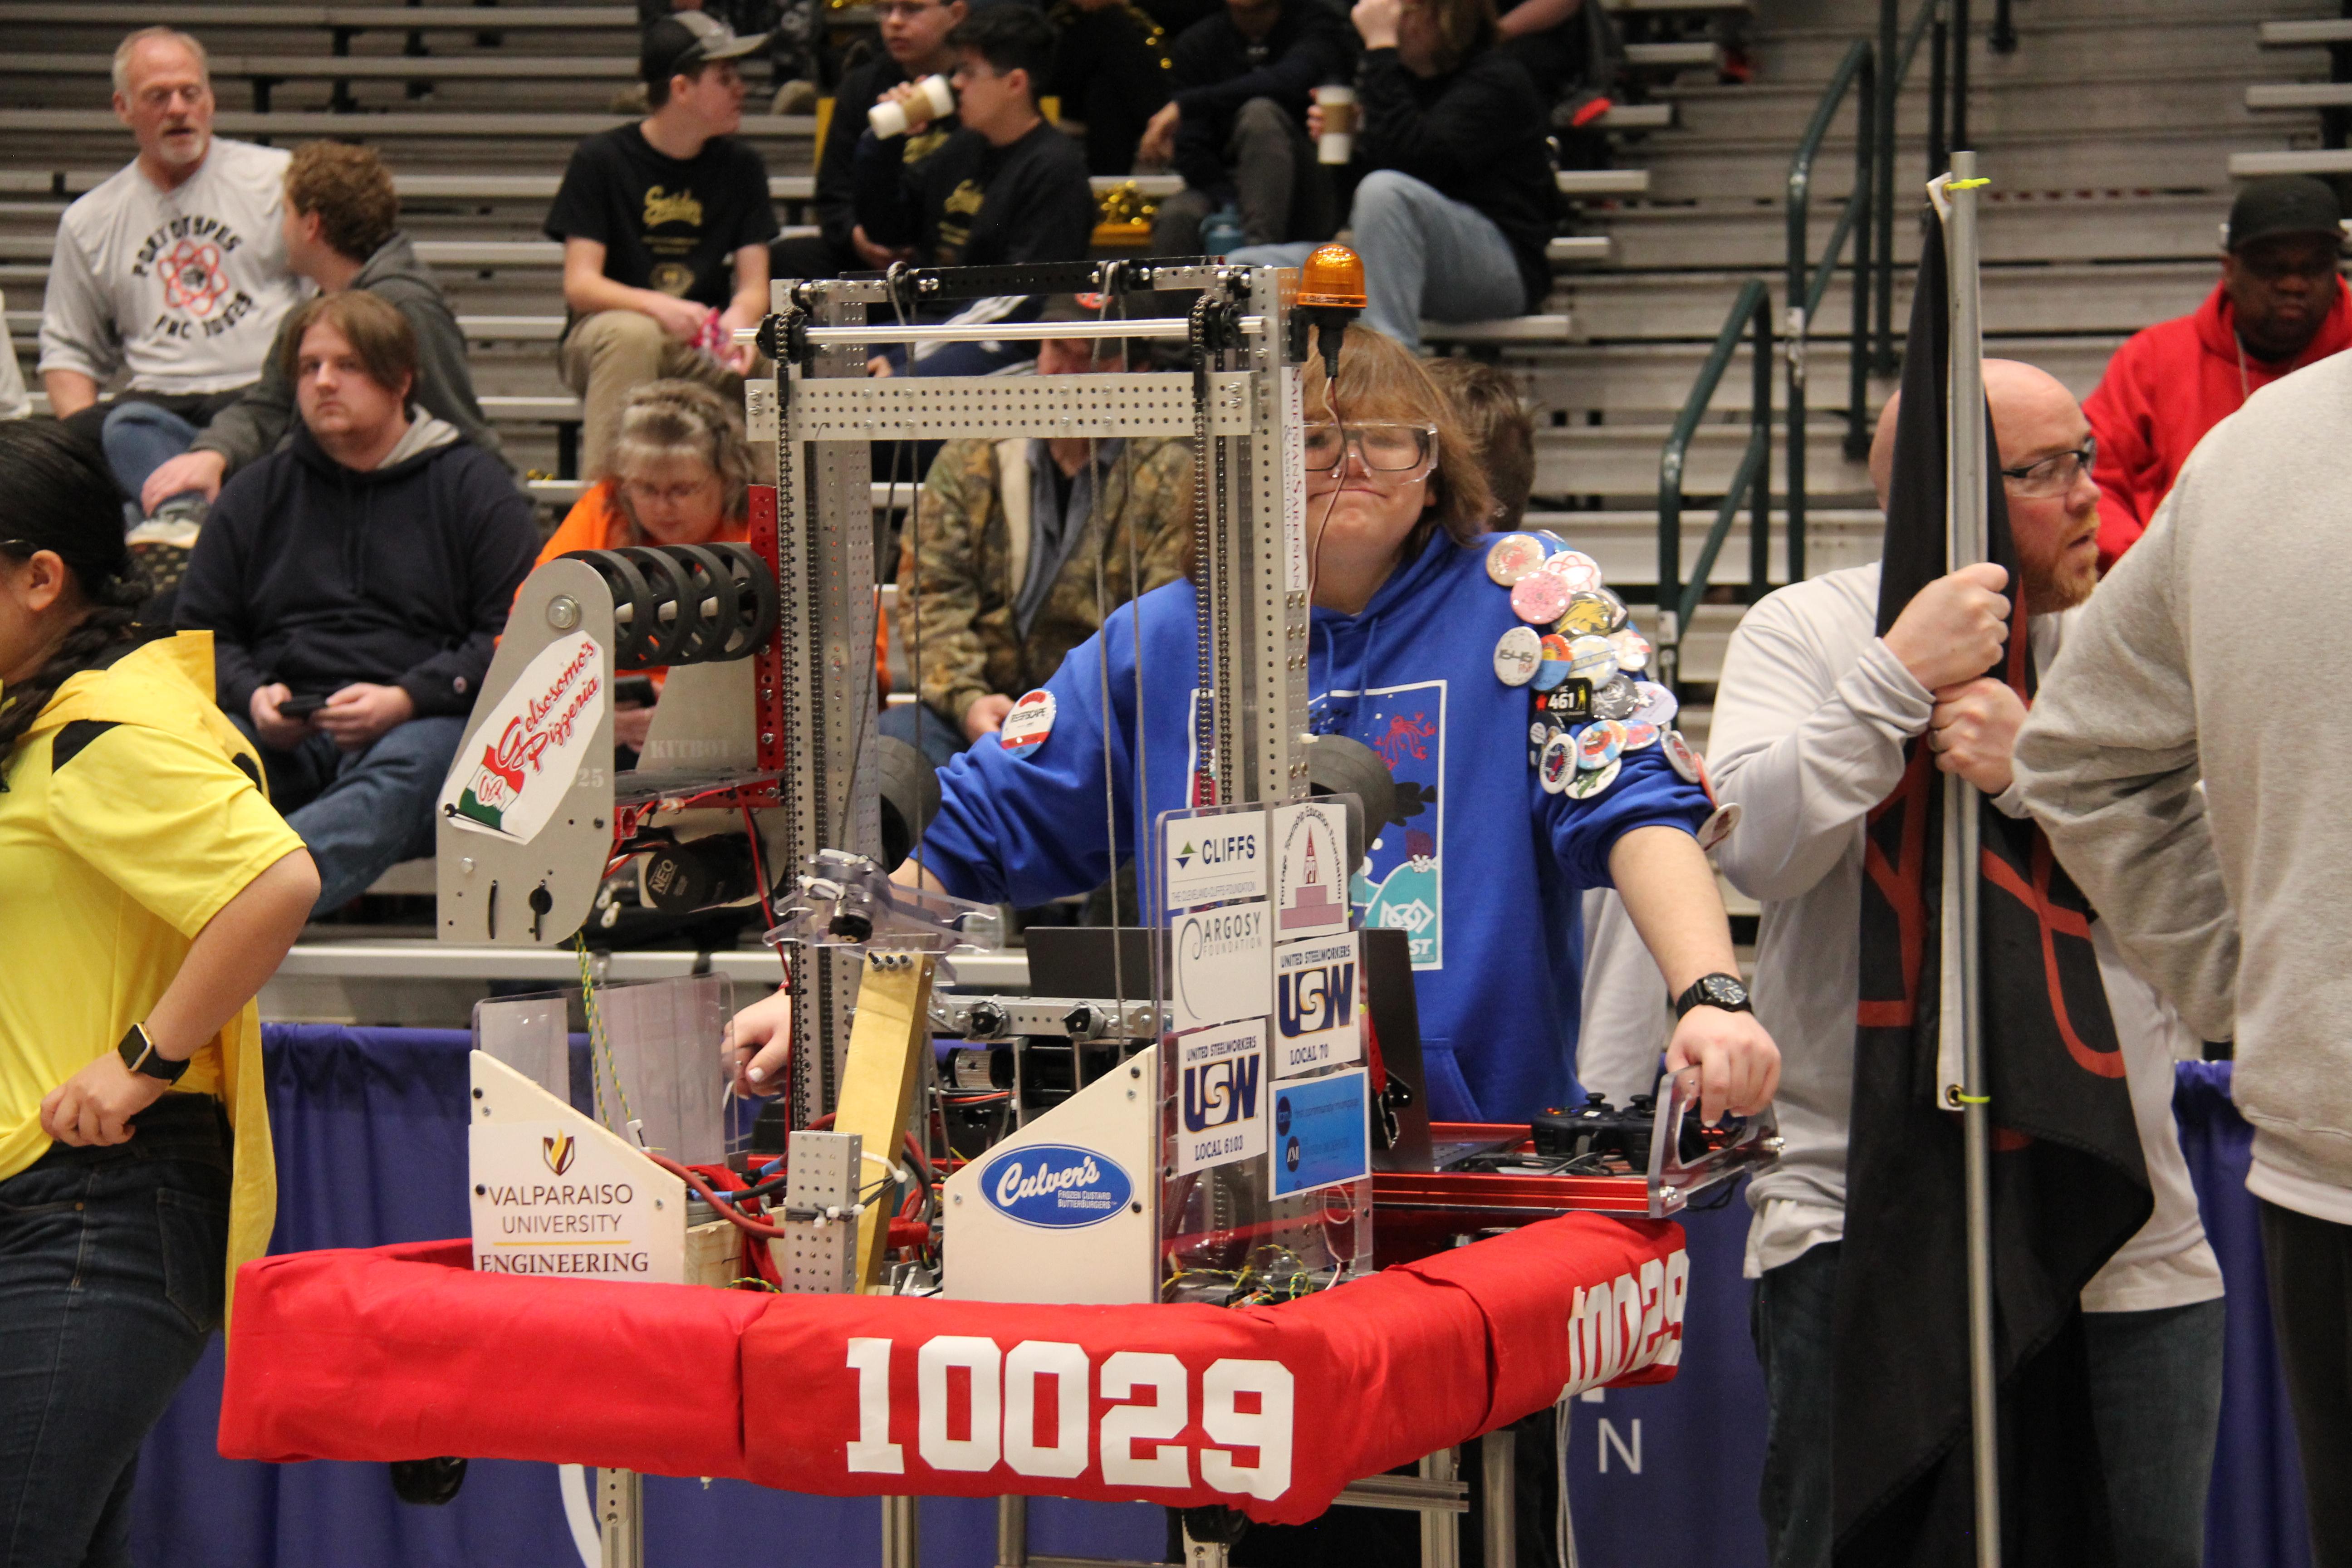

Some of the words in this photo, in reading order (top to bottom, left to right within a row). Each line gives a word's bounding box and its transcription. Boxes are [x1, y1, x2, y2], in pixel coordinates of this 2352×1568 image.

[1292, 368, 1302, 477] SARKISIAN
[1292, 480, 1303, 588] SARKISIAN
[498, 640, 595, 768] Gelsosomo's
[1548, 692, 1574, 709] 461
[519, 676, 598, 771] Pizzeria
[1202, 834, 1255, 864] CLIFFS
[652, 859, 674, 893] NEO
[1204, 911, 1261, 942] ARGOSY
[1203, 937, 1262, 957] FOUNDATION
[1280, 952, 1302, 968] UNITED
[1303, 945, 1351, 963] STEELWORKERS
[1279, 961, 1355, 1039] USW
[1186, 1046, 1208, 1062] UNITED
[1210, 1036, 1256, 1057] STEELWORKERS
[1290, 1046, 1317, 1065] LOCAL
[1184, 1052, 1261, 1134] USW
[1195, 1139, 1222, 1161] LOCAL
[1225, 1135, 1244, 1152] 6103
[489, 1183, 633, 1206] VALPARAISO
[996, 1156, 1100, 1207] Culver's
[1058, 1190, 1081, 1199] FROZEN
[1082, 1190, 1111, 1200] CUSTARD
[503, 1214, 622, 1234] UNIVERSITY
[479, 1252, 649, 1274] ENGINEERING
[1553, 1249, 1690, 1407] 10029
[846, 1335, 1294, 1501] 10029
